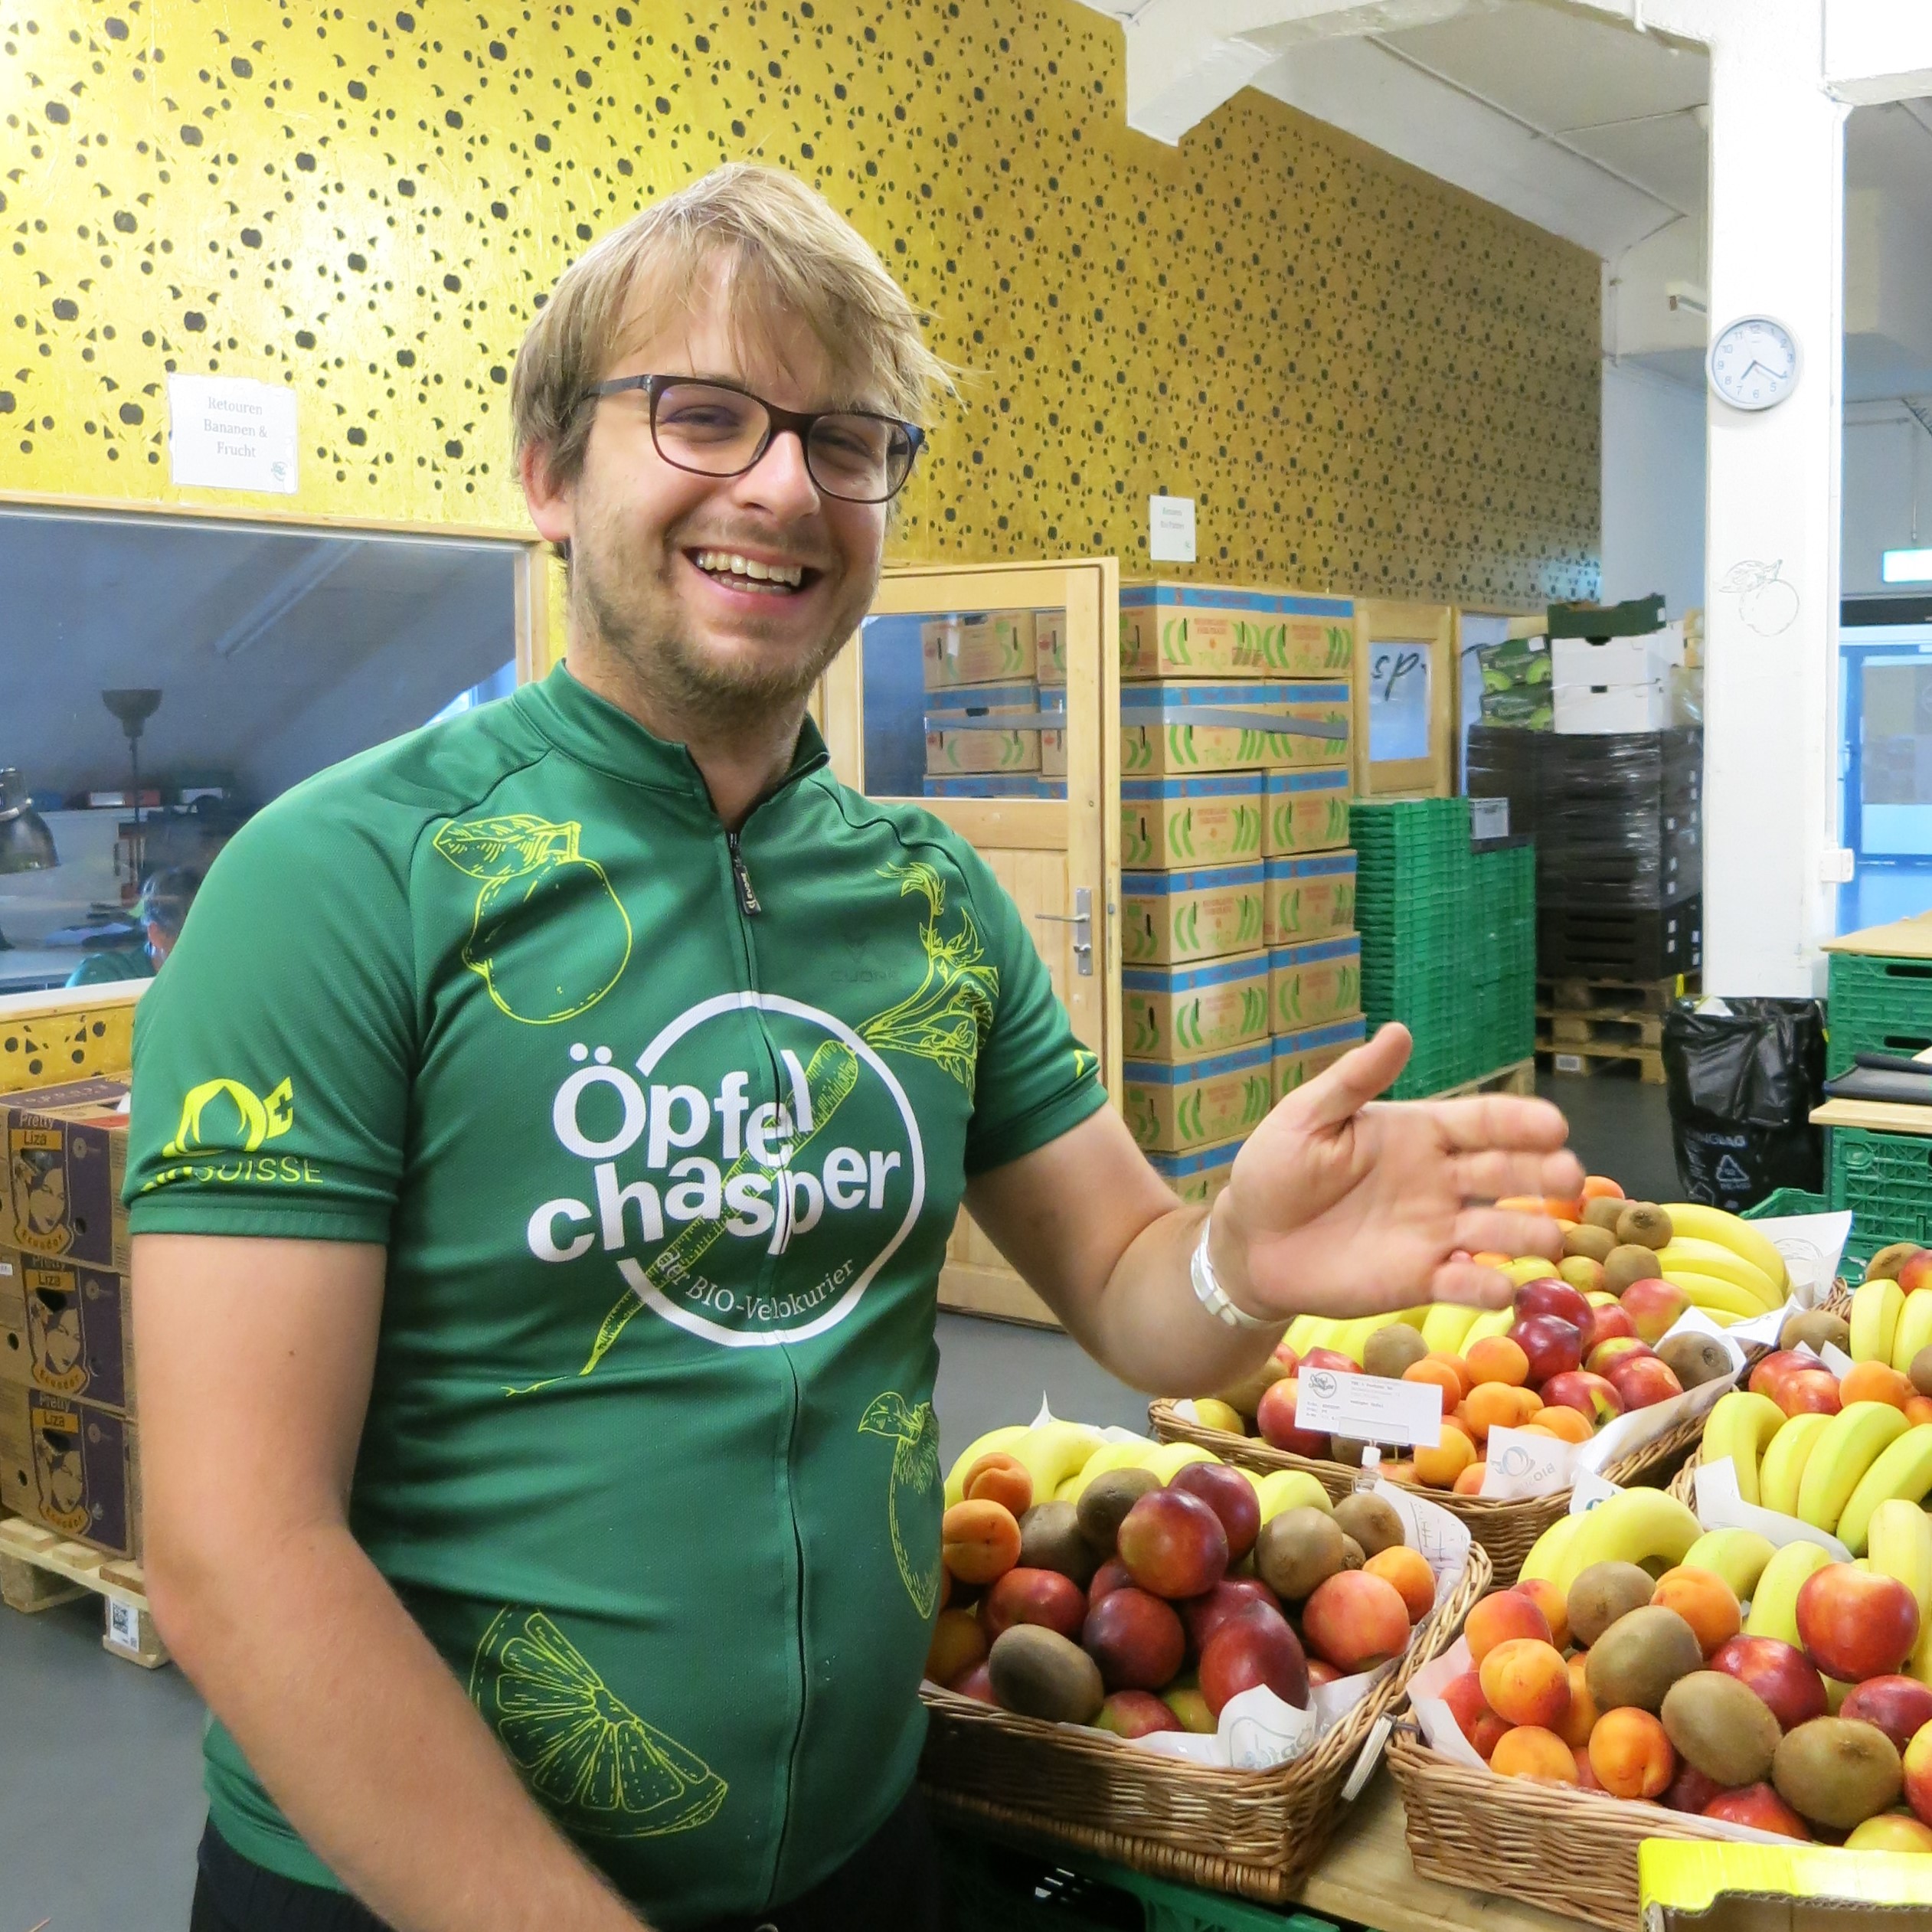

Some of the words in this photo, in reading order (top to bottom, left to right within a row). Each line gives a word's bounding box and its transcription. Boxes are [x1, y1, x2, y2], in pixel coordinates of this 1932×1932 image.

[1718, 361, 1724, 370] 9
[1753, 389, 1760, 399] 6
[208, 397, 263, 416] Retouren
[204, 418, 256, 436] Bananen
[259, 425, 268, 438] &
[217, 441, 257, 458] Frucht
[553, 1042, 814, 1169] Öpfel
[19, 1111, 54, 1131] Pretty
[23, 1130, 47, 1146] Liza
[527, 1146, 901, 1263] chasper
[38, 1271, 61, 1287] Liza
[657, 1250, 691, 1286] der
[685, 1258, 854, 1321] BIO-Velokurier
[43, 1411, 65, 1428] Liza
